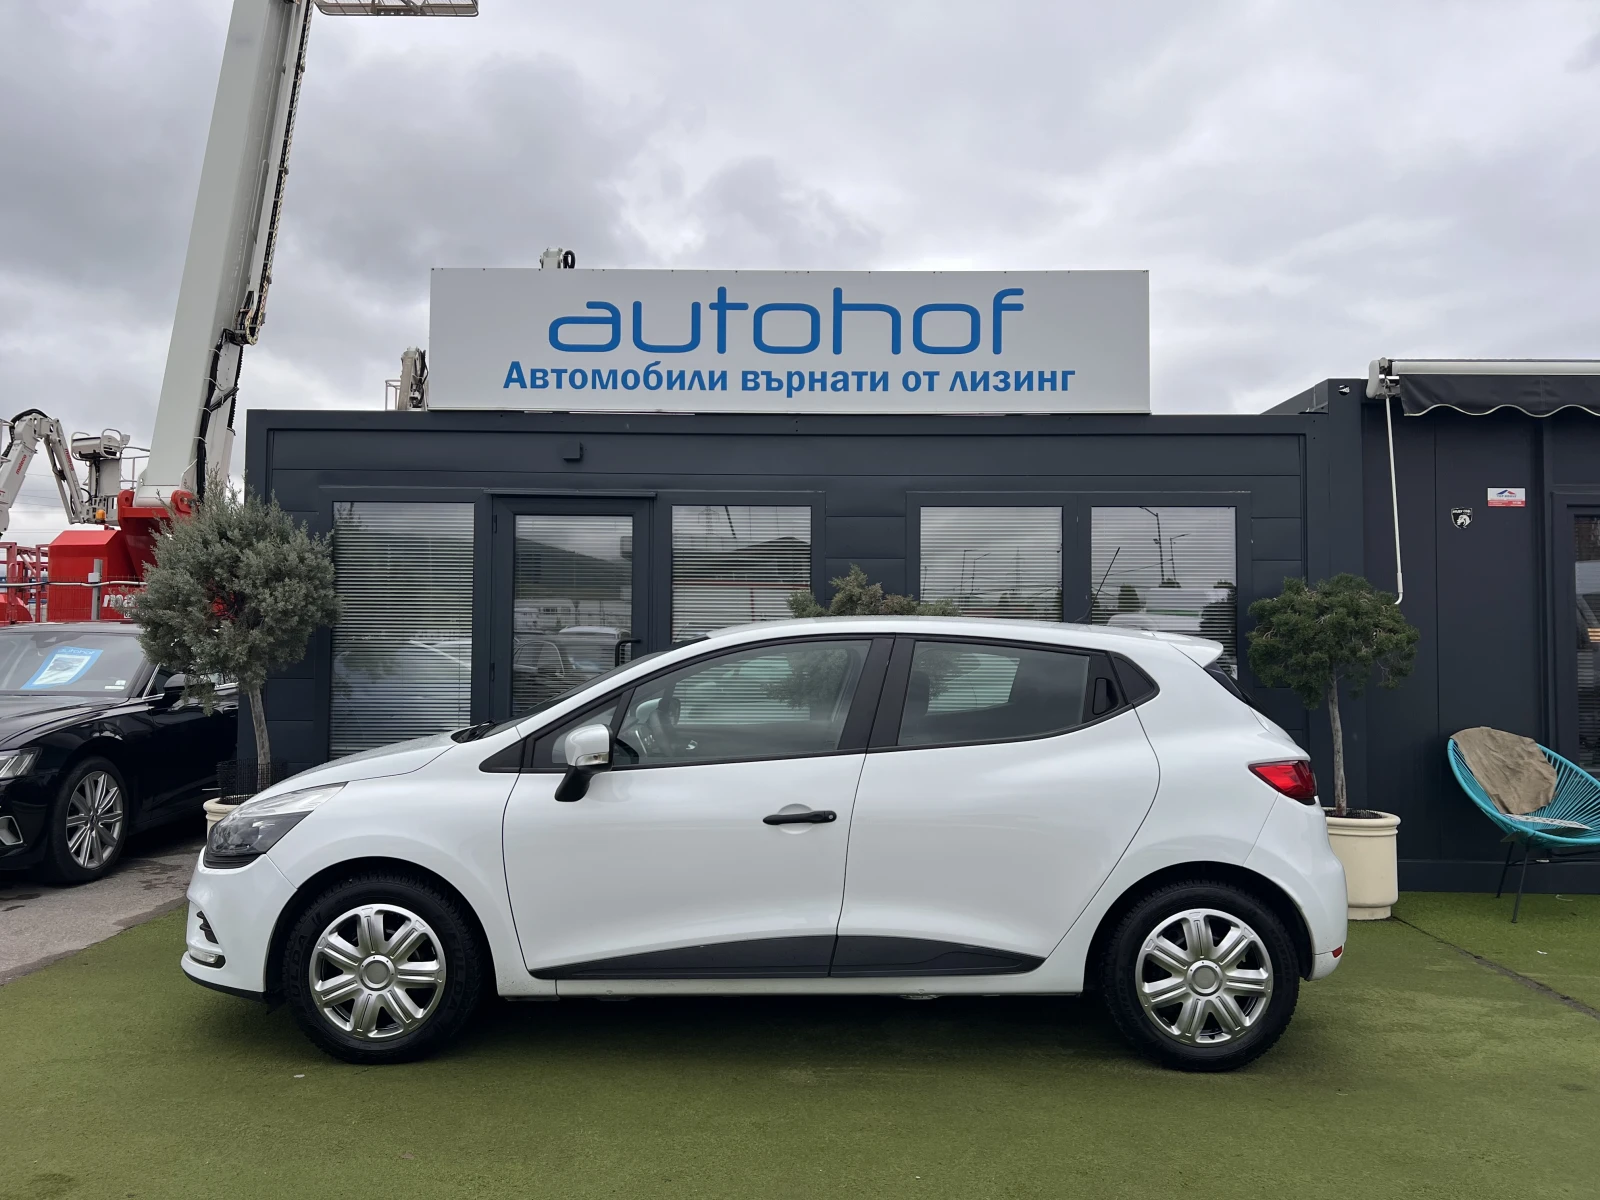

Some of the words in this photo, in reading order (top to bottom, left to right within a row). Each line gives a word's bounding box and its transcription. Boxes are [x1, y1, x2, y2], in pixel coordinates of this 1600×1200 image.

[548, 286, 1024, 355] autohof
[503, 361, 728, 392] Автомобили
[741, 370, 889, 399] върнати
[902, 371, 940, 393] от
[949, 370, 1076, 393] лизинг
[15, 454, 28, 475] mateco
